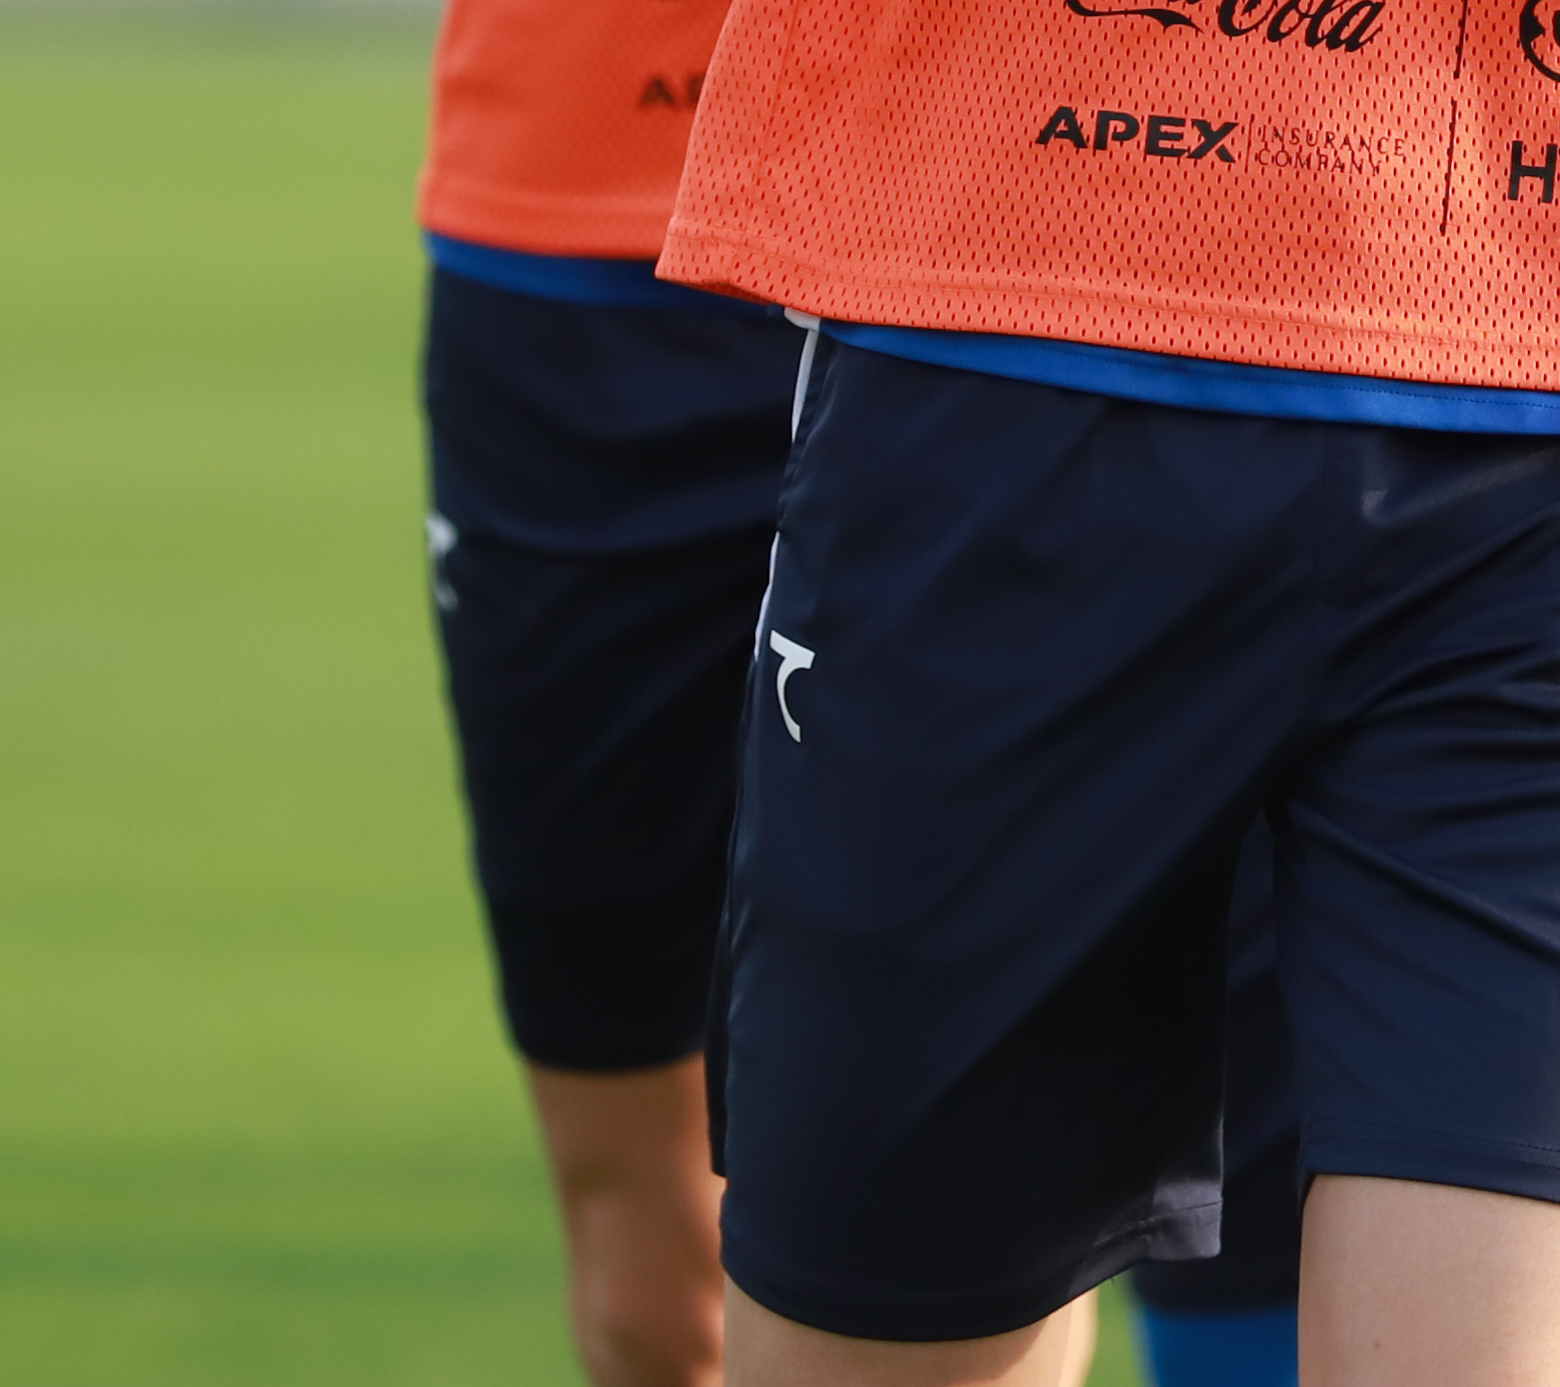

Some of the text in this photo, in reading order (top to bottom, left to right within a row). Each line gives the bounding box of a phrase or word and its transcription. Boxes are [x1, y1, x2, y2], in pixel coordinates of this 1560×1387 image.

[1035, 106, 1239, 164] APEX
[1259, 123, 1406, 157] INSURANCE
[1257, 148, 1384, 177] COMPANY
